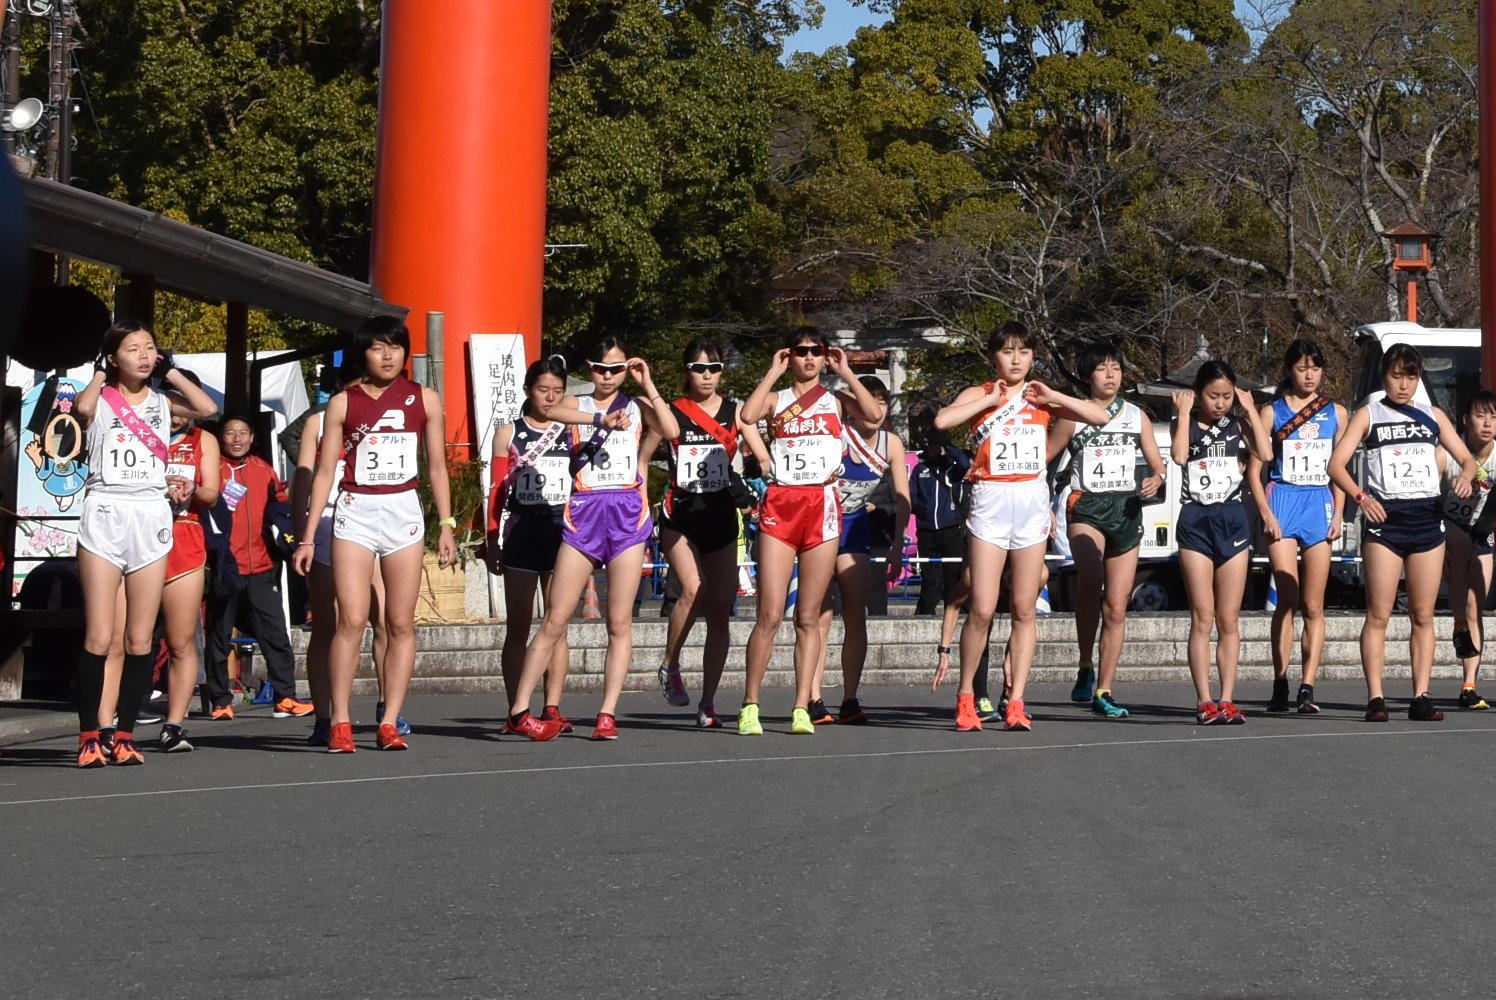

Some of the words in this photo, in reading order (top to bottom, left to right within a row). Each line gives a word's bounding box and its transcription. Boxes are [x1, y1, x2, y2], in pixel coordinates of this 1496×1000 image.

[1012, 427, 1036, 435] アルト
[1376, 423, 1434, 442] 関西大学
[381, 435, 407, 444] アルト
[797, 439, 822, 447] アルト
[700, 447, 722, 455] アルト
[995, 441, 1039, 460] 21-1
[1304, 442, 1327, 450] アルト
[1104, 448, 1127, 456] アルト
[110, 449, 156, 468] 10-1
[366, 451, 405, 470] 3-1
[782, 453, 827, 472] 15-1
[1288, 455, 1328, 472] 11-1
[684, 461, 723, 479] 18-1
[998, 461, 1040, 471] 全日本選抜
[1092, 462, 1127, 478] 4-1
[1388, 461, 1431, 479] 12-1
[120, 469, 149, 480] 玉川大
[368, 471, 406, 481] 立命館大
[597, 473, 625, 482] 佛教大
[792, 472, 819, 481] 福岡大
[1290, 474, 1328, 482] 日本体育大
[522, 473, 565, 491] 19-1
[1090, 479, 1129, 489] 東京農業大
[1400, 480, 1425, 488] 関西大
[518, 492, 567, 502] 関西外国語大
